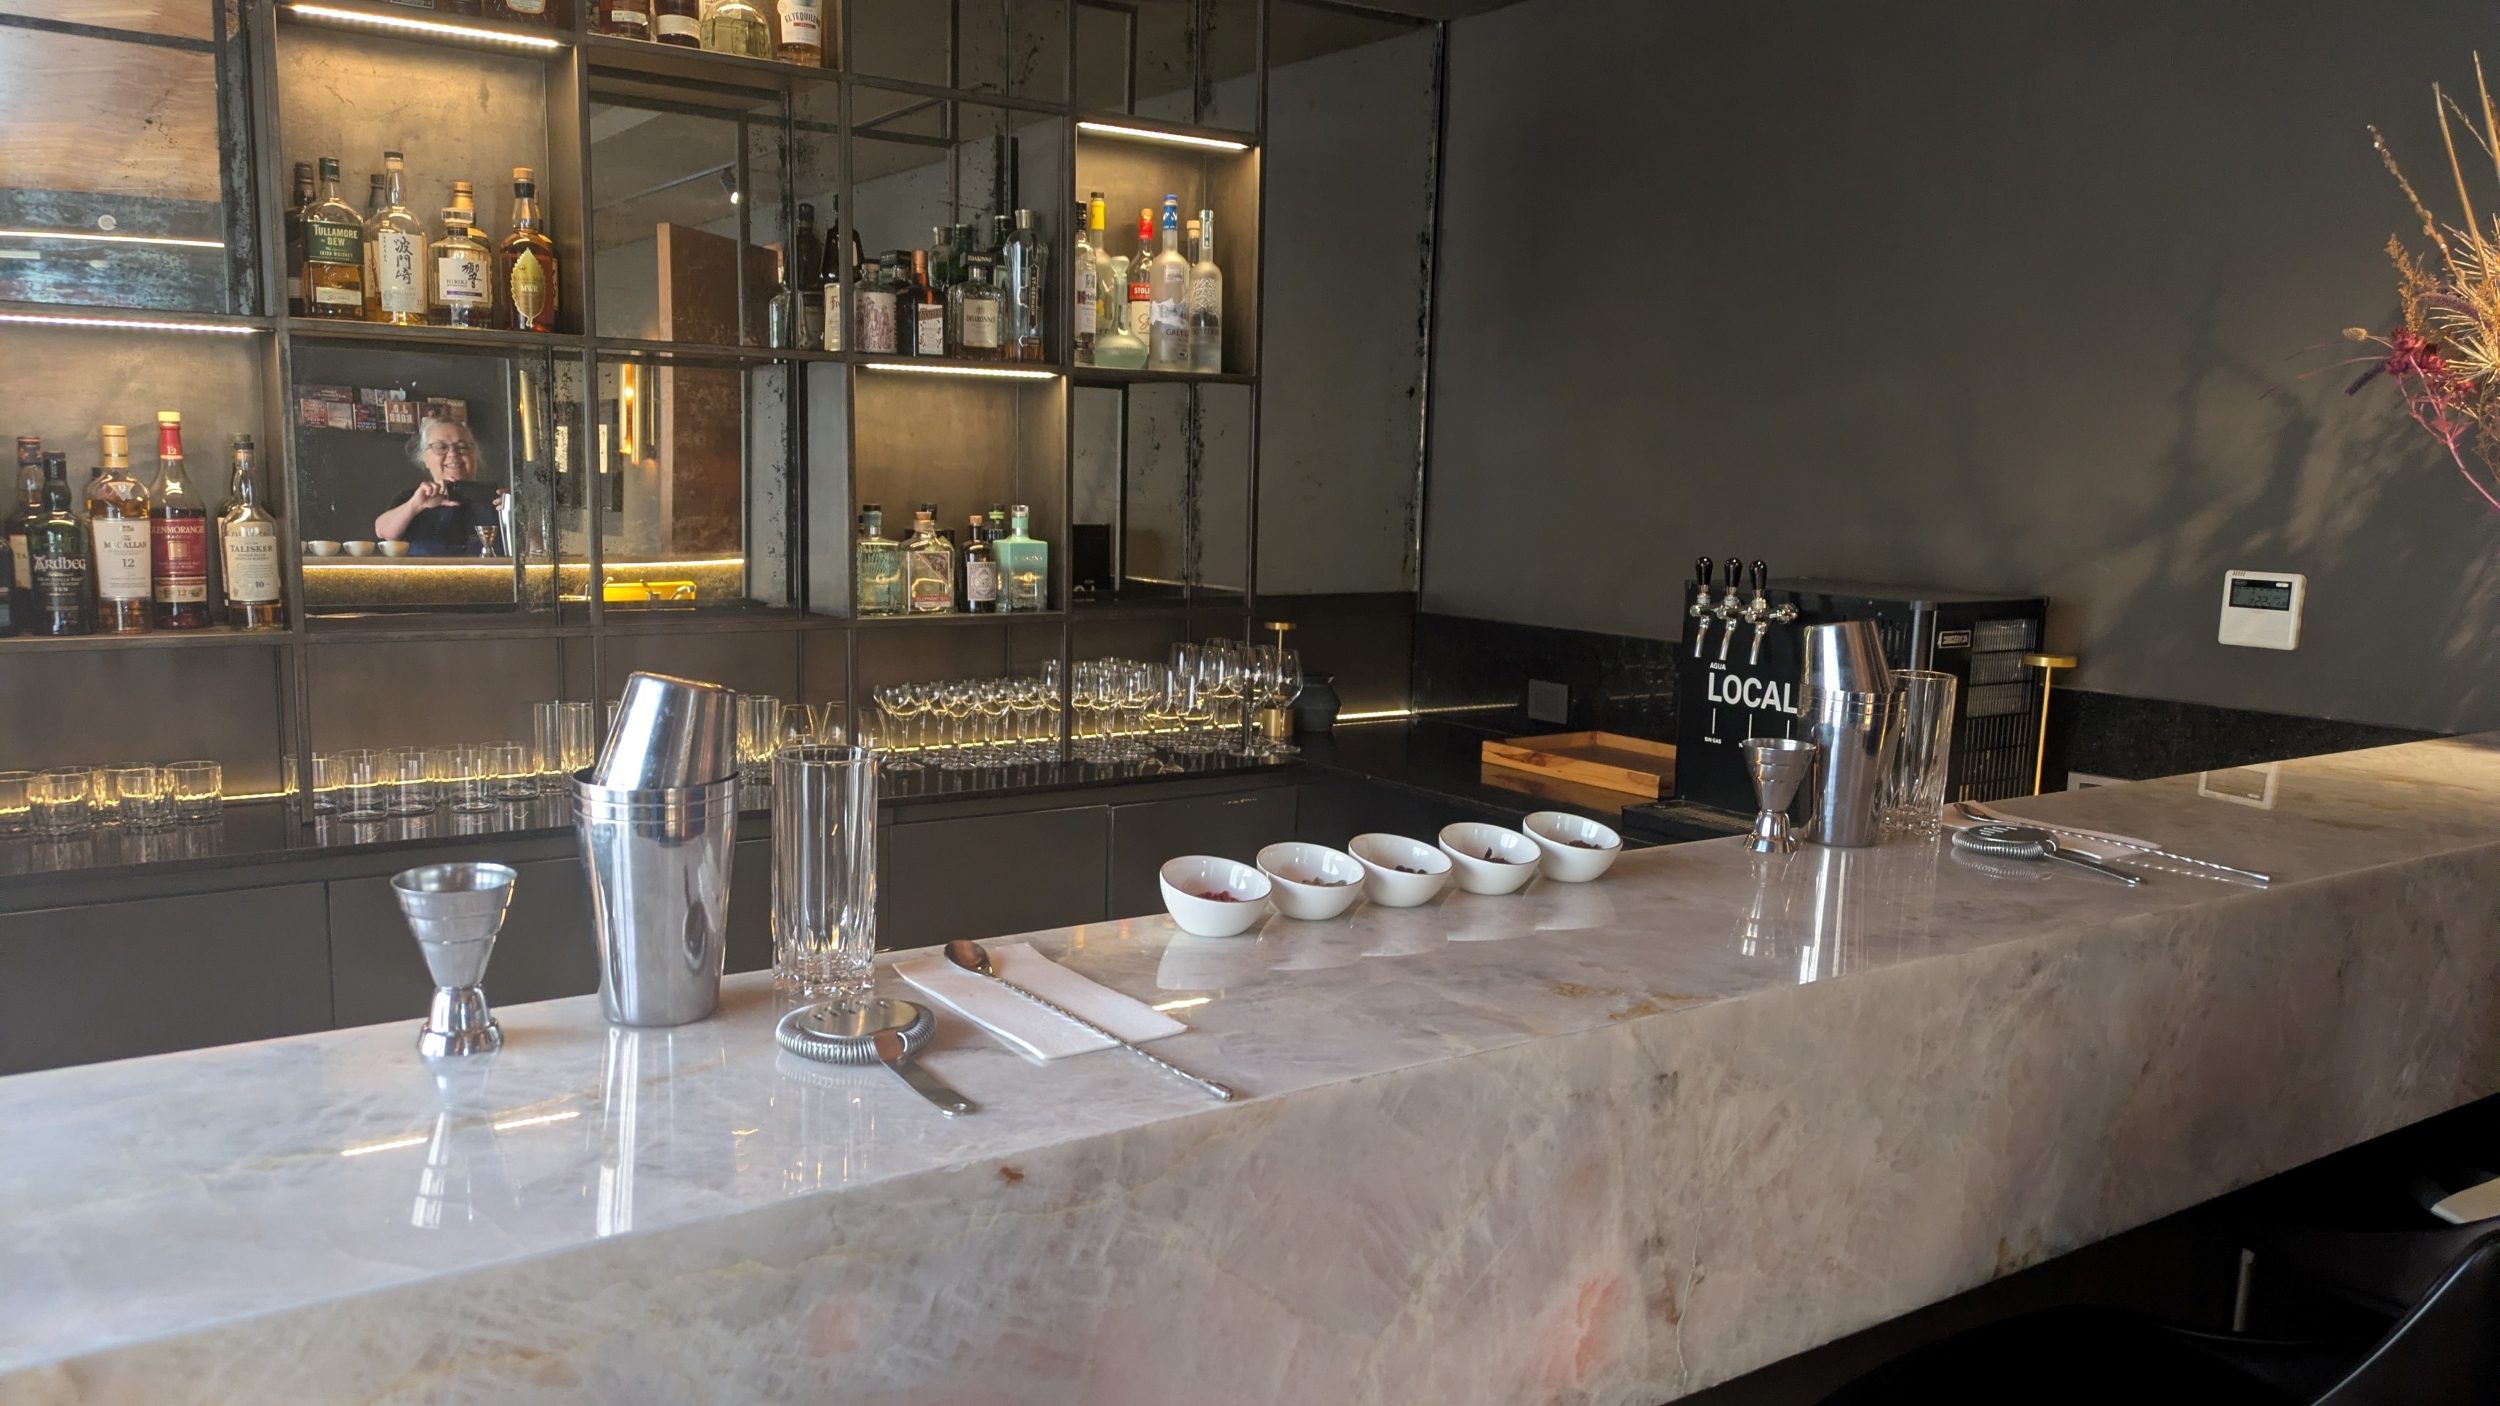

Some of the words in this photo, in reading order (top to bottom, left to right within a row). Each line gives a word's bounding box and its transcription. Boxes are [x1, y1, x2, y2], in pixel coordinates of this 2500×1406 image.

[313, 224, 358, 239] TULLAMORE
[230, 545, 273, 553] TALISKER
[122, 558, 135, 568] 12
[1709, 662, 1726, 670] AGUA
[1708, 672, 1797, 714] LOCAL
